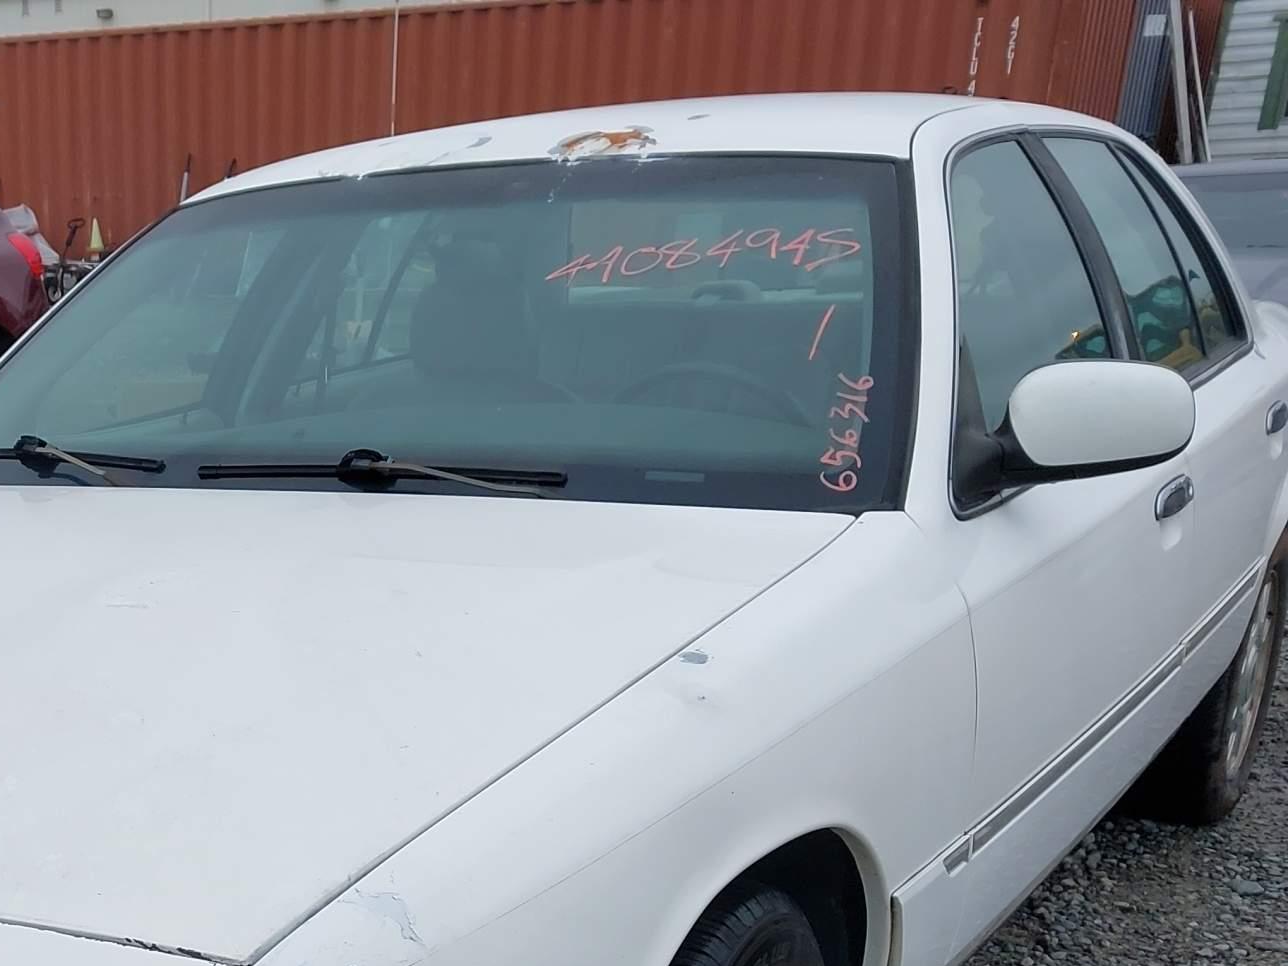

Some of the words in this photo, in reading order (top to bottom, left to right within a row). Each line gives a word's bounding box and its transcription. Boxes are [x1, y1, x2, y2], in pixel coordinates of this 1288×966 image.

[970, 17, 984, 75] TCLU
[1007, 15, 1020, 75] 42G1
[544, 228, 861, 286] 44084945
[820, 373, 874, 491] 656316
